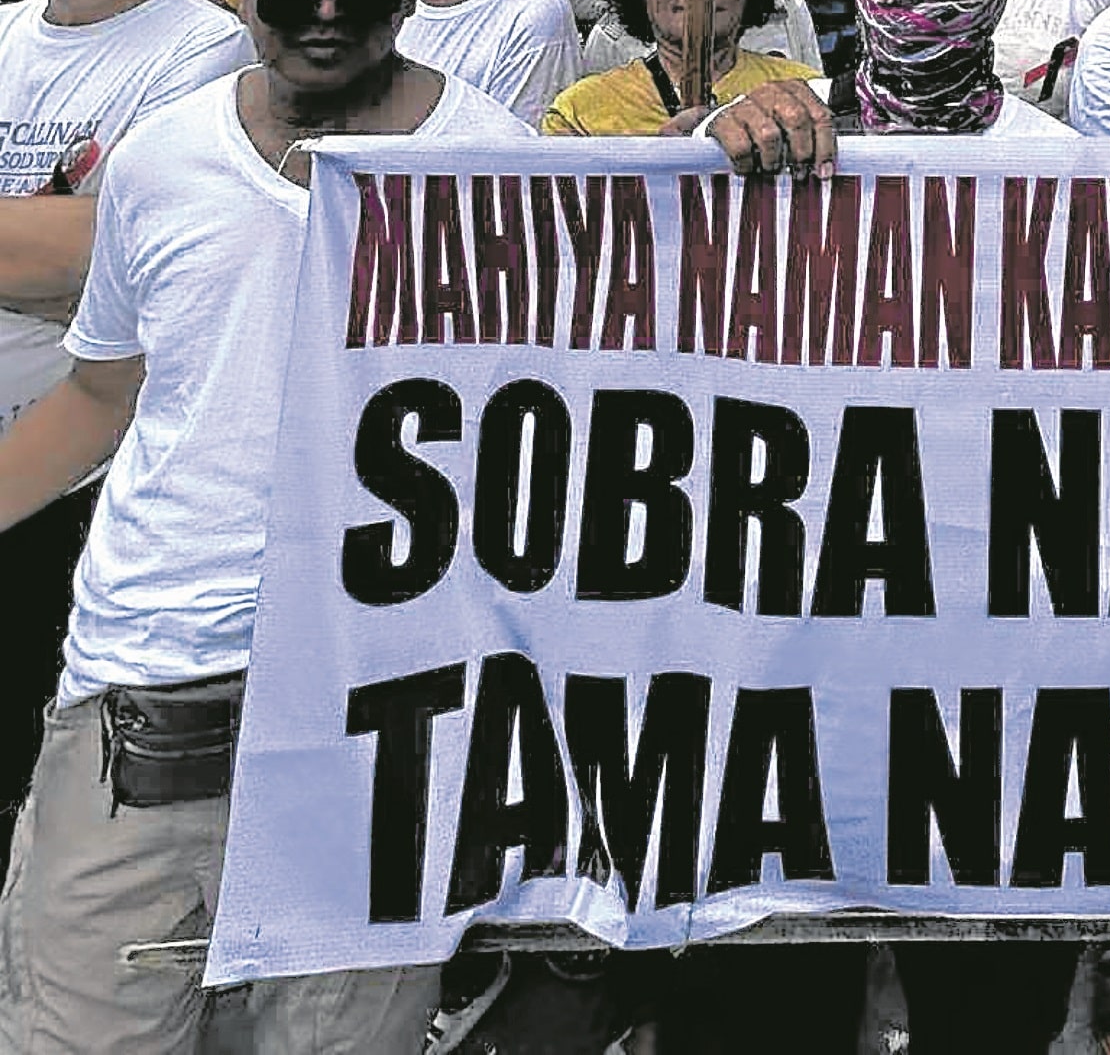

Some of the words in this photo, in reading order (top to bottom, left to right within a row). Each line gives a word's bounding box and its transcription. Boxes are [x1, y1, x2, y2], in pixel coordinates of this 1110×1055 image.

[344, 172, 656, 350] MAHIYA
[677, 173, 975, 370] NAMAN
[340, 376, 937, 619] SOBRA
[344, 650, 836, 924] TAMA
